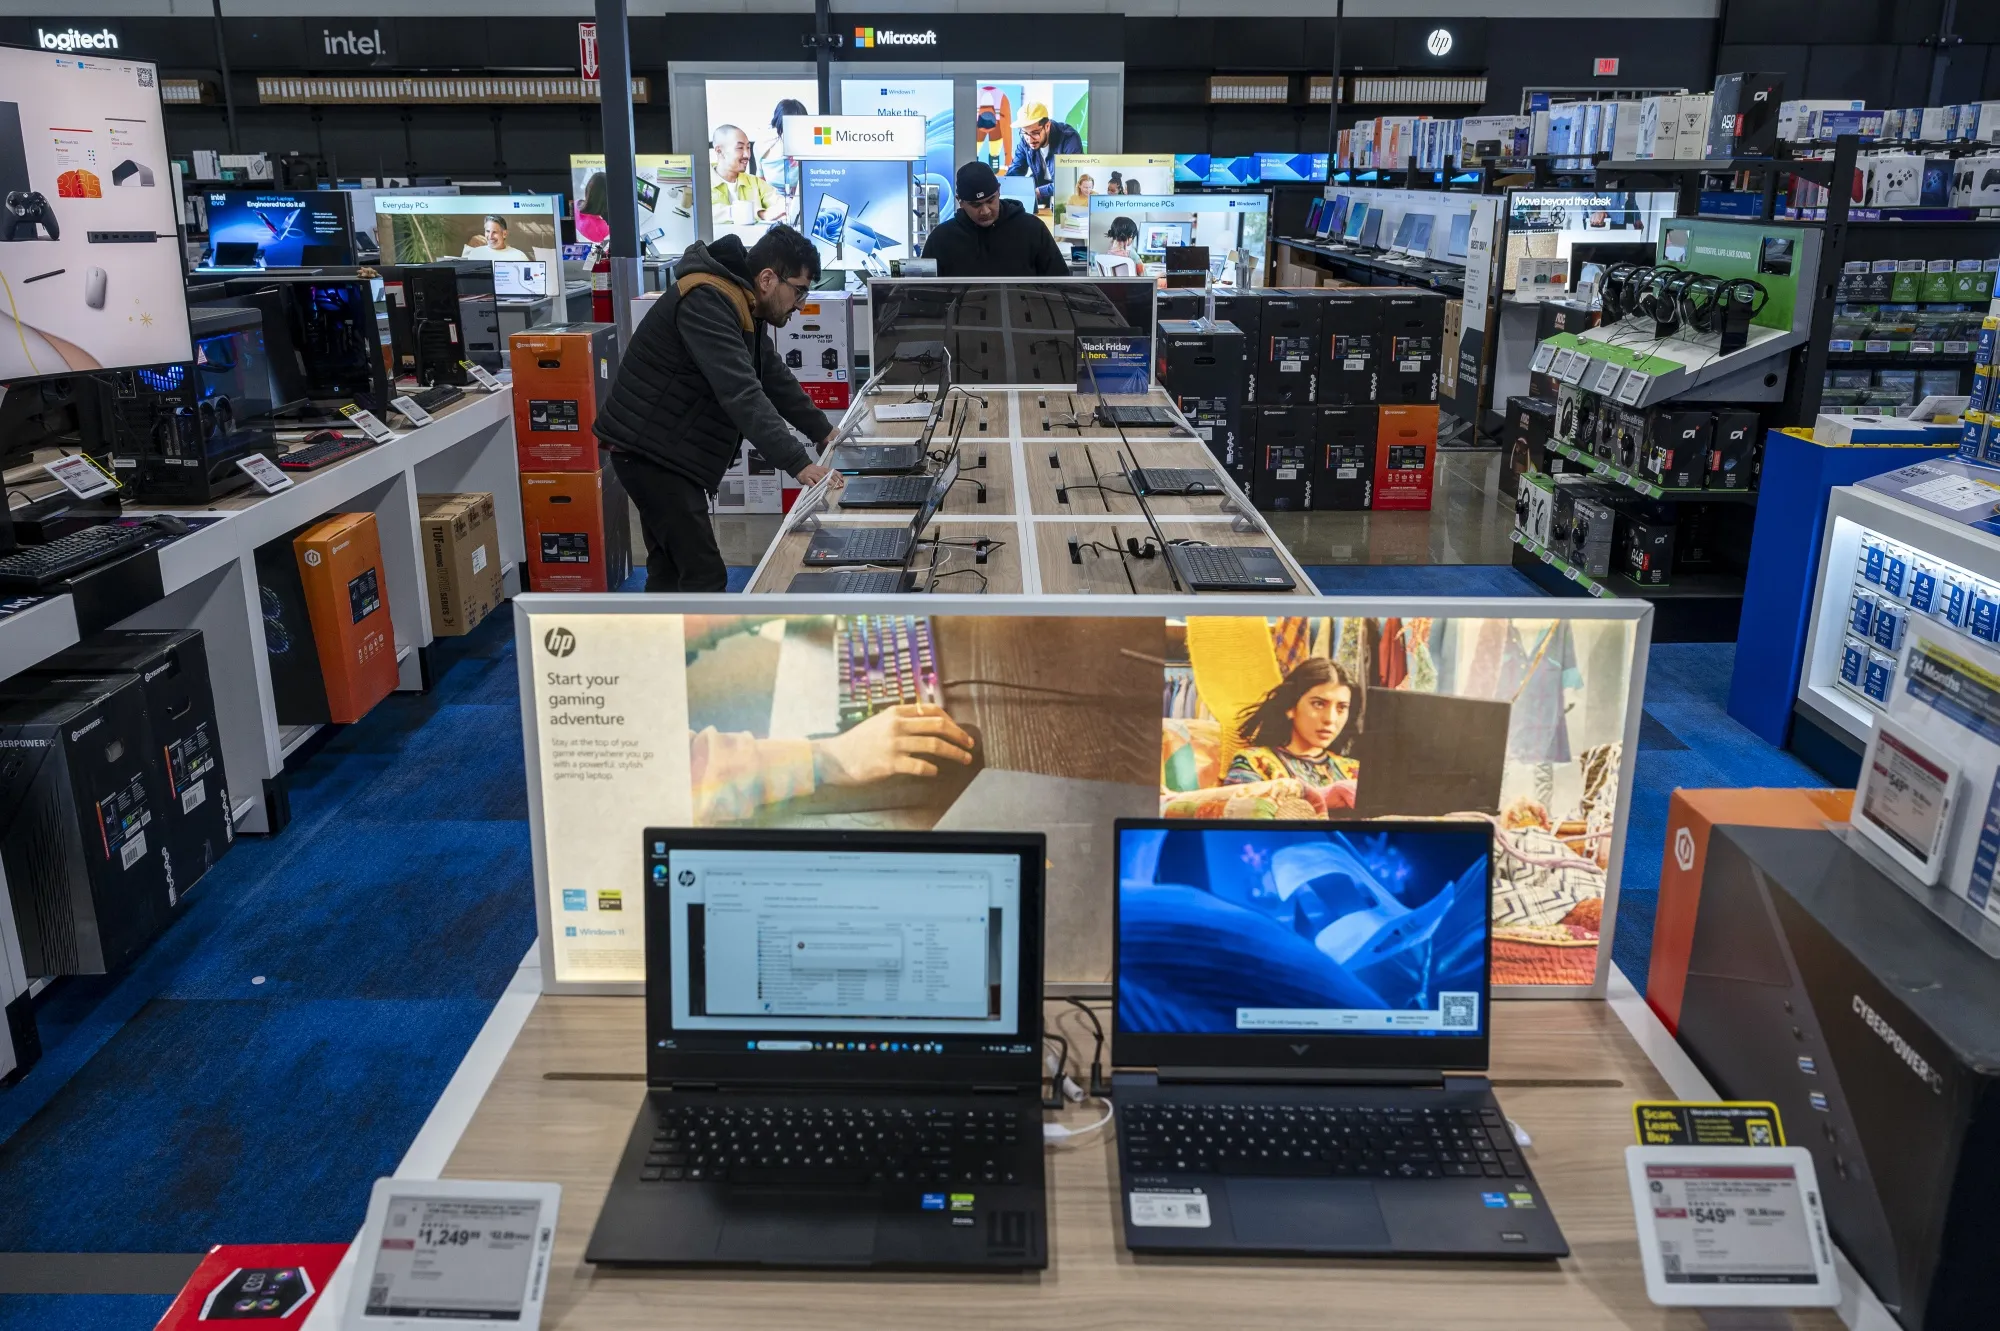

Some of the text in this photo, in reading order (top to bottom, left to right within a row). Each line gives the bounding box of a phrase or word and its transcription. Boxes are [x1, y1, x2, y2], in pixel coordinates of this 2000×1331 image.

[38, 29, 119, 51] logitech
[877, 30, 936, 45] Microsoft
[1598, 59, 1616, 73] EXIT
[877, 108, 918, 116] Make the
[836, 130, 894, 142] Microsoft
[1515, 196, 1612, 207] Move beyond the desk
[1470, 240, 1488, 251] BEST BUY
[1082, 343, 1131, 353] Black Friday
[432, 526, 445, 544] TUF
[435, 543, 444, 568] GAMING
[439, 591, 450, 616] SERIES
[545, 627, 576, 658] hp
[547, 672, 620, 689] Start your
[1911, 656, 1924, 672] 24
[1924, 661, 1961, 693] Months
[549, 692, 605, 709] gaming
[550, 712, 625, 725] adventure
[0, 739, 56, 748] BERPOWERPC
[552, 738, 568, 748] Stay
[579, 738, 593, 746] the
[594, 739, 609, 749] top
[610, 739, 620, 747] of
[620, 740, 639, 749] your
[552, 750, 654, 760] game everywhere you go
[553, 760, 571, 768] with
[618, 761, 643, 770] stylish
[554, 771, 585, 781] gaming
[580, 928, 616, 936] Windows
[1852, 994, 1943, 1095] CYBERPOWERPC
[1643, 1108, 1676, 1120] Scan.
[1644, 1120, 1682, 1131] Learn.
[1646, 1131, 1673, 1144] Buy.
[1689, 1207, 1726, 1224] $549
[419, 1229, 470, 1247] $1,249
